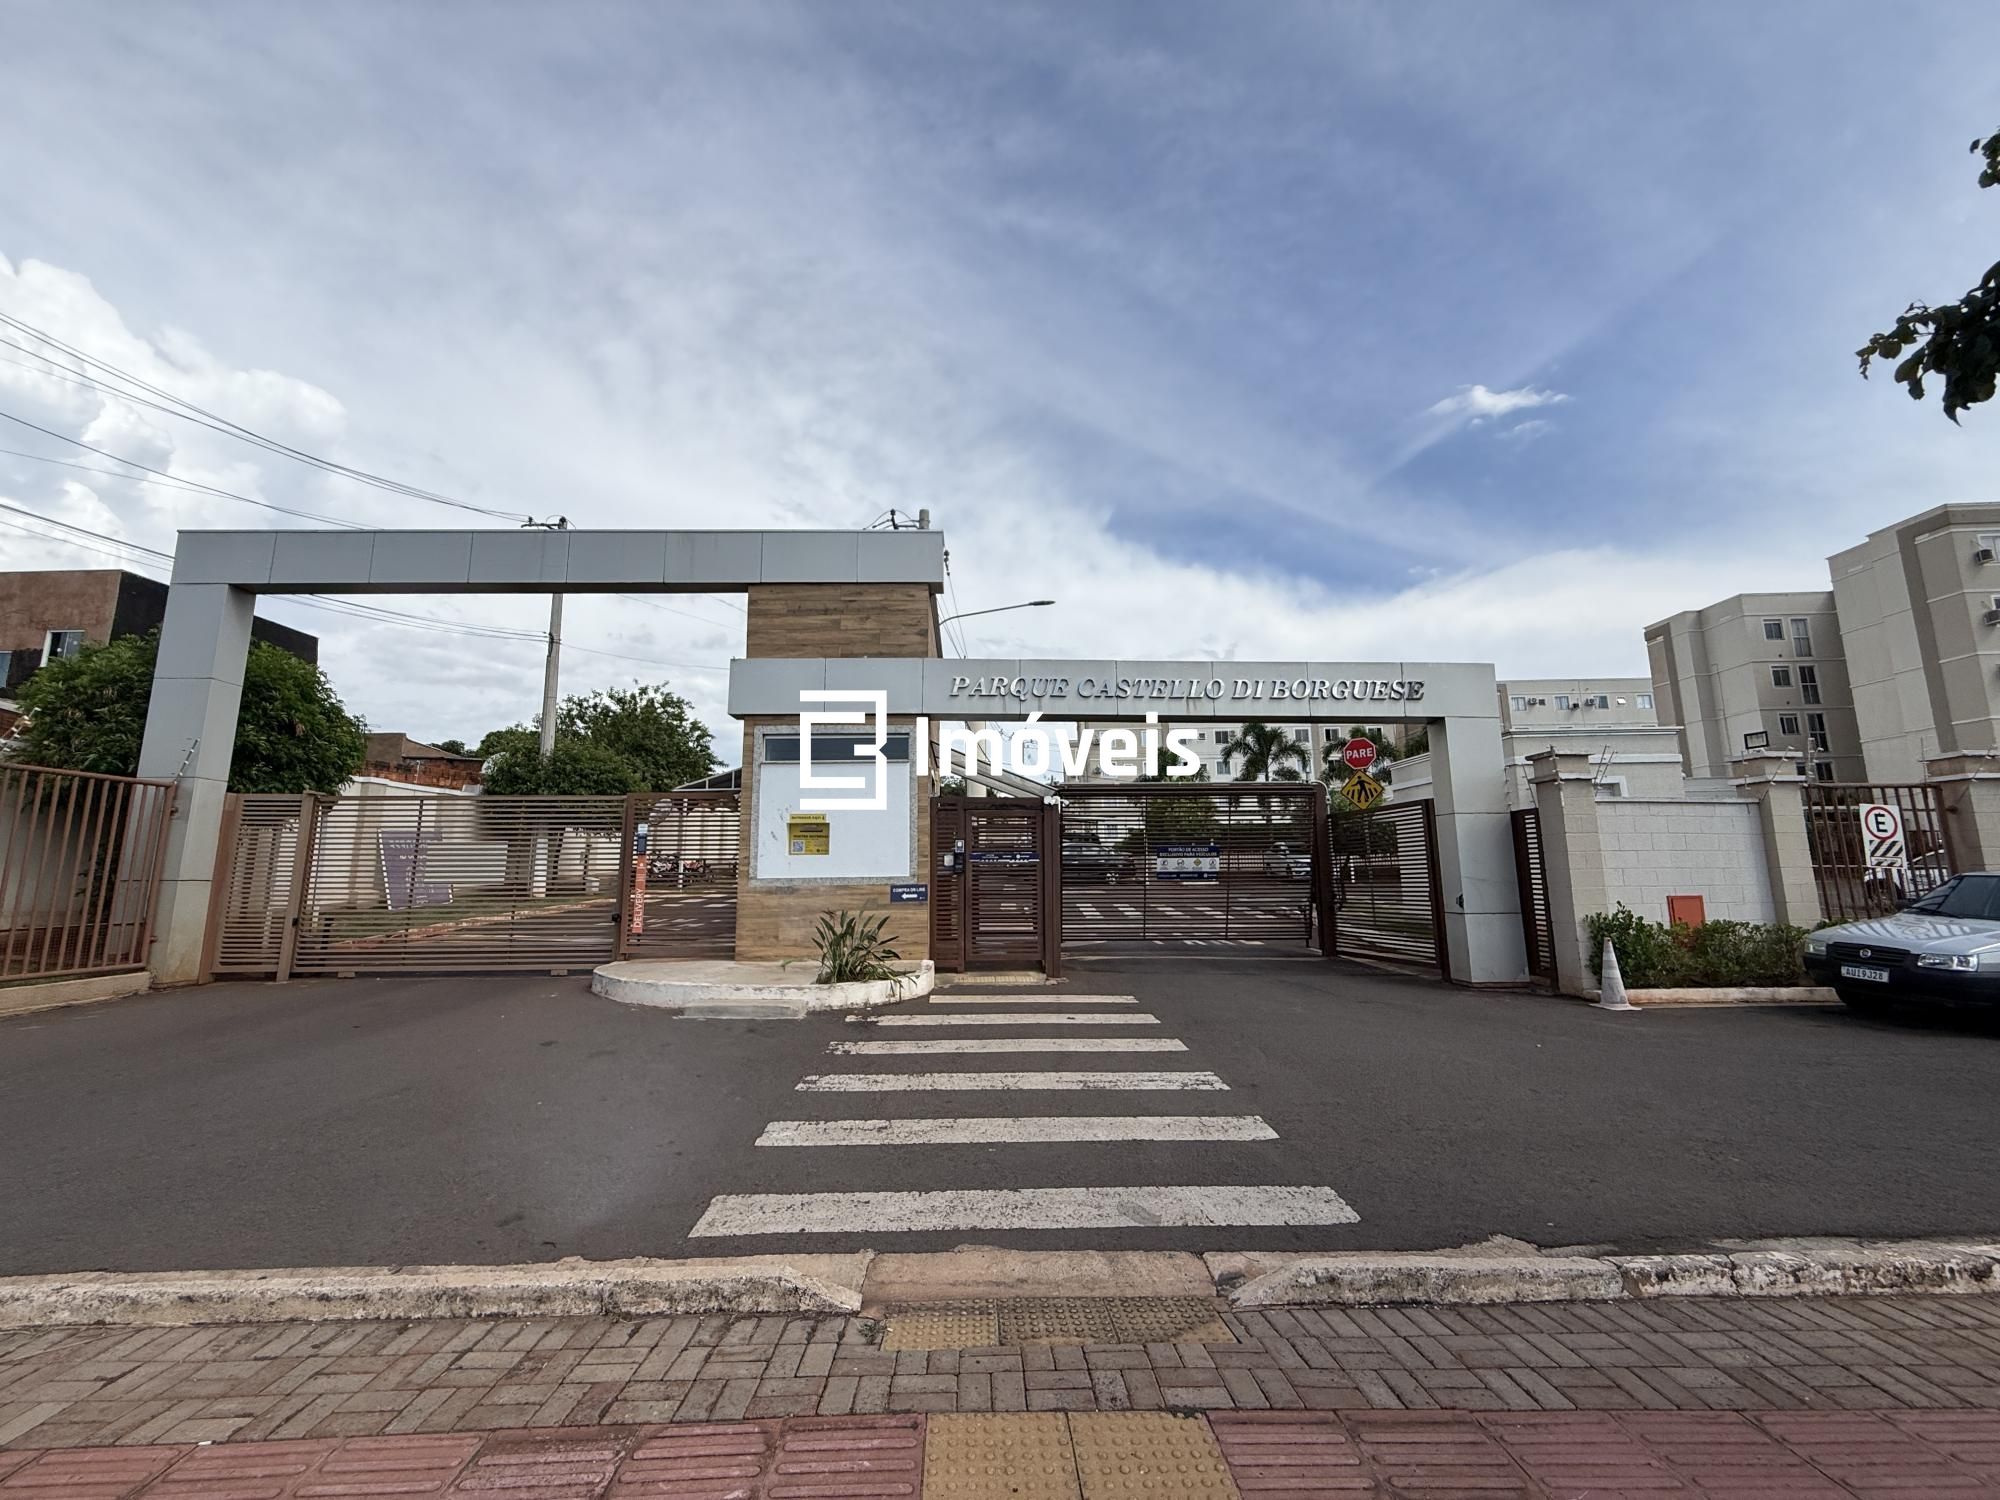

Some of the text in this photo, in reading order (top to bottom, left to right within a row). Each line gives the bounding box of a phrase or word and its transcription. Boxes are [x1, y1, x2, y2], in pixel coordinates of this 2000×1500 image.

[949, 676, 1425, 701] PARQUE CASTELLO DI BORGUESE
[1346, 747, 1374, 760] PARE
[1874, 812, 1889, 833] E
[634, 888, 644, 928] DELIVERY
